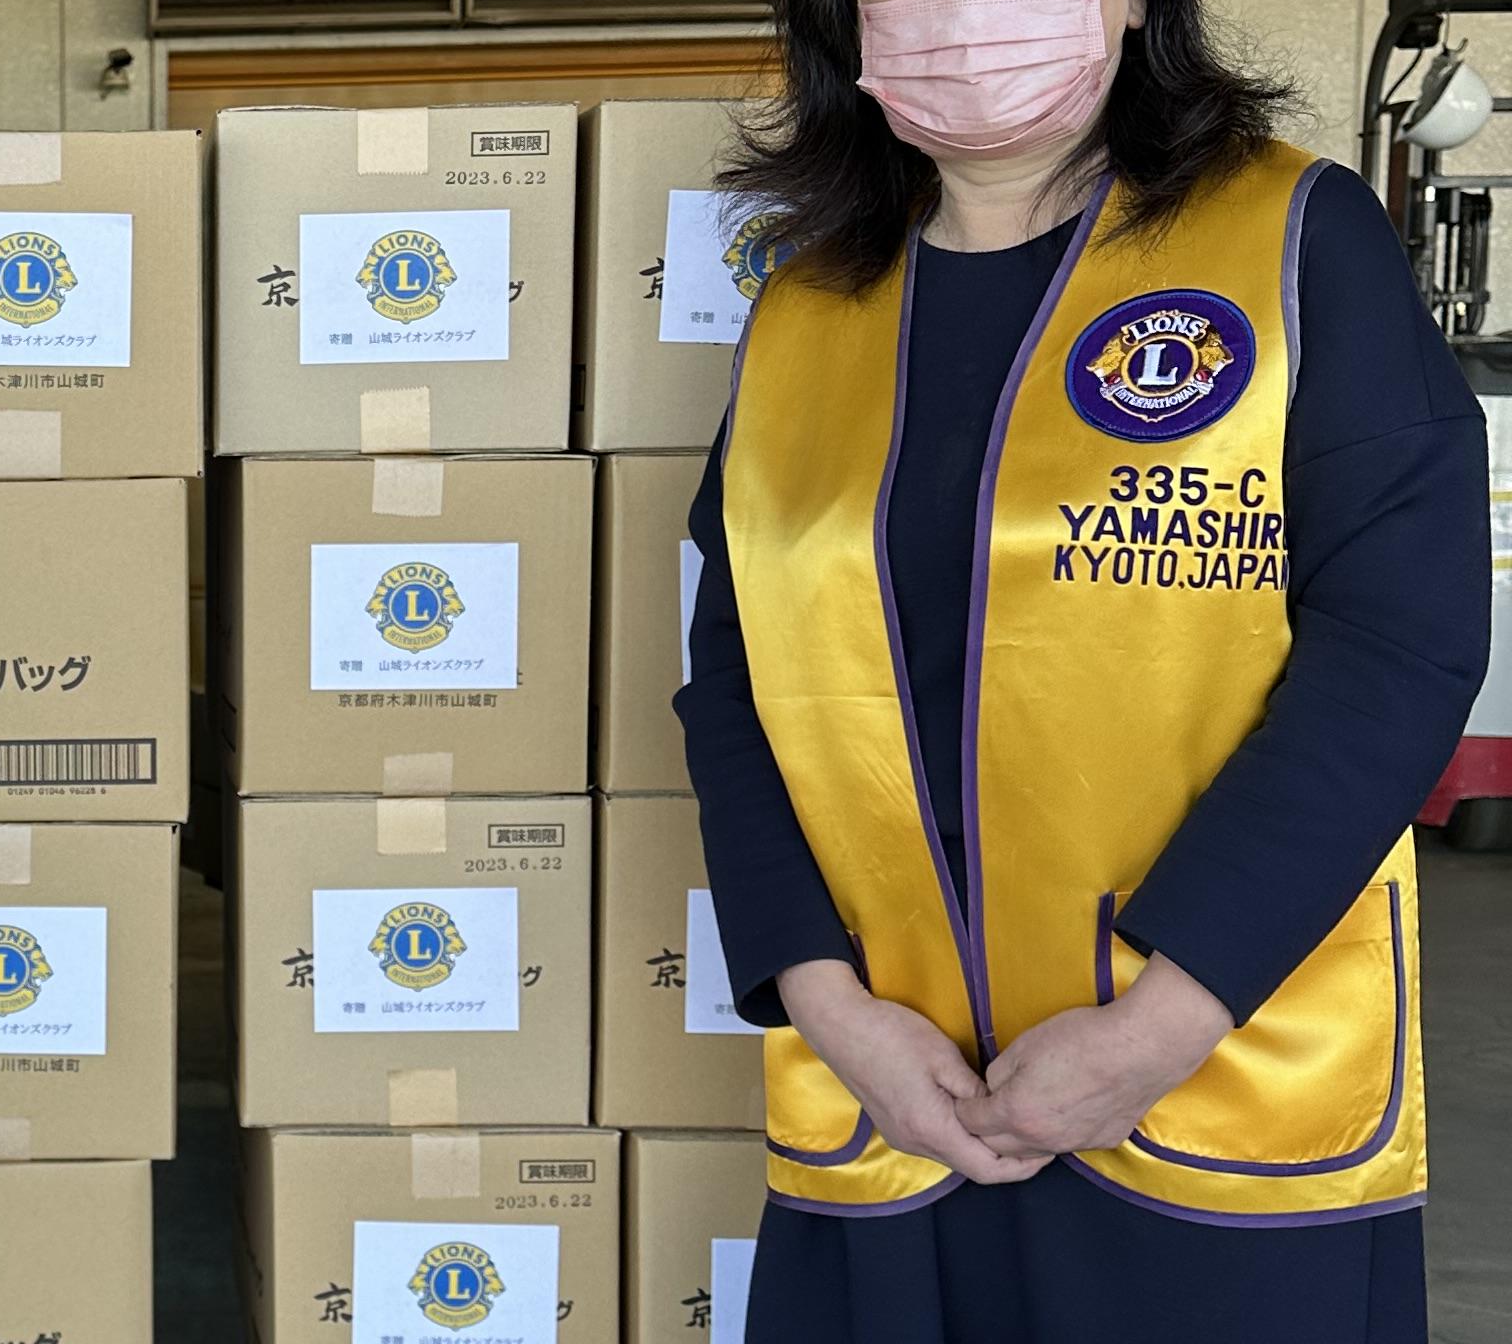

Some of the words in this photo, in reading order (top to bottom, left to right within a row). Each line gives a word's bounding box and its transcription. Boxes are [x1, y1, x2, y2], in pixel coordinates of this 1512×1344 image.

[479, 135, 542, 153] 賞味期限
[445, 171, 547, 186] 2023.6.22
[0, 235, 56, 256] LIONS
[378, 234, 436, 255] LIONS
[16, 262, 41, 294] L
[395, 259, 421, 292] L
[369, 329, 476, 344] 山城ライオンズクラブ
[1129, 317, 1203, 340] LIONS
[1138, 343, 1178, 385] L
[1115, 386, 1198, 409] INTERNATIONAL
[1110, 466, 1267, 507] 335-C
[1058, 505, 1287, 551] YAMASHIR
[387, 566, 443, 586] LIONS
[404, 590, 430, 622] L
[378, 659, 484, 672] 山城ライオンズクラブ
[339, 693, 499, 708] 京都府木津川市山城町
[496, 828, 558, 844] 賞味期限
[463, 857, 563, 873] 2023.6.22
[390, 906, 446, 927] LIONS
[406, 929, 432, 960] L
[494, 1194, 593, 1210] 2023.6.22
[429, 1245, 483, 1266] LIONS
[445, 1269, 471, 1300] L
